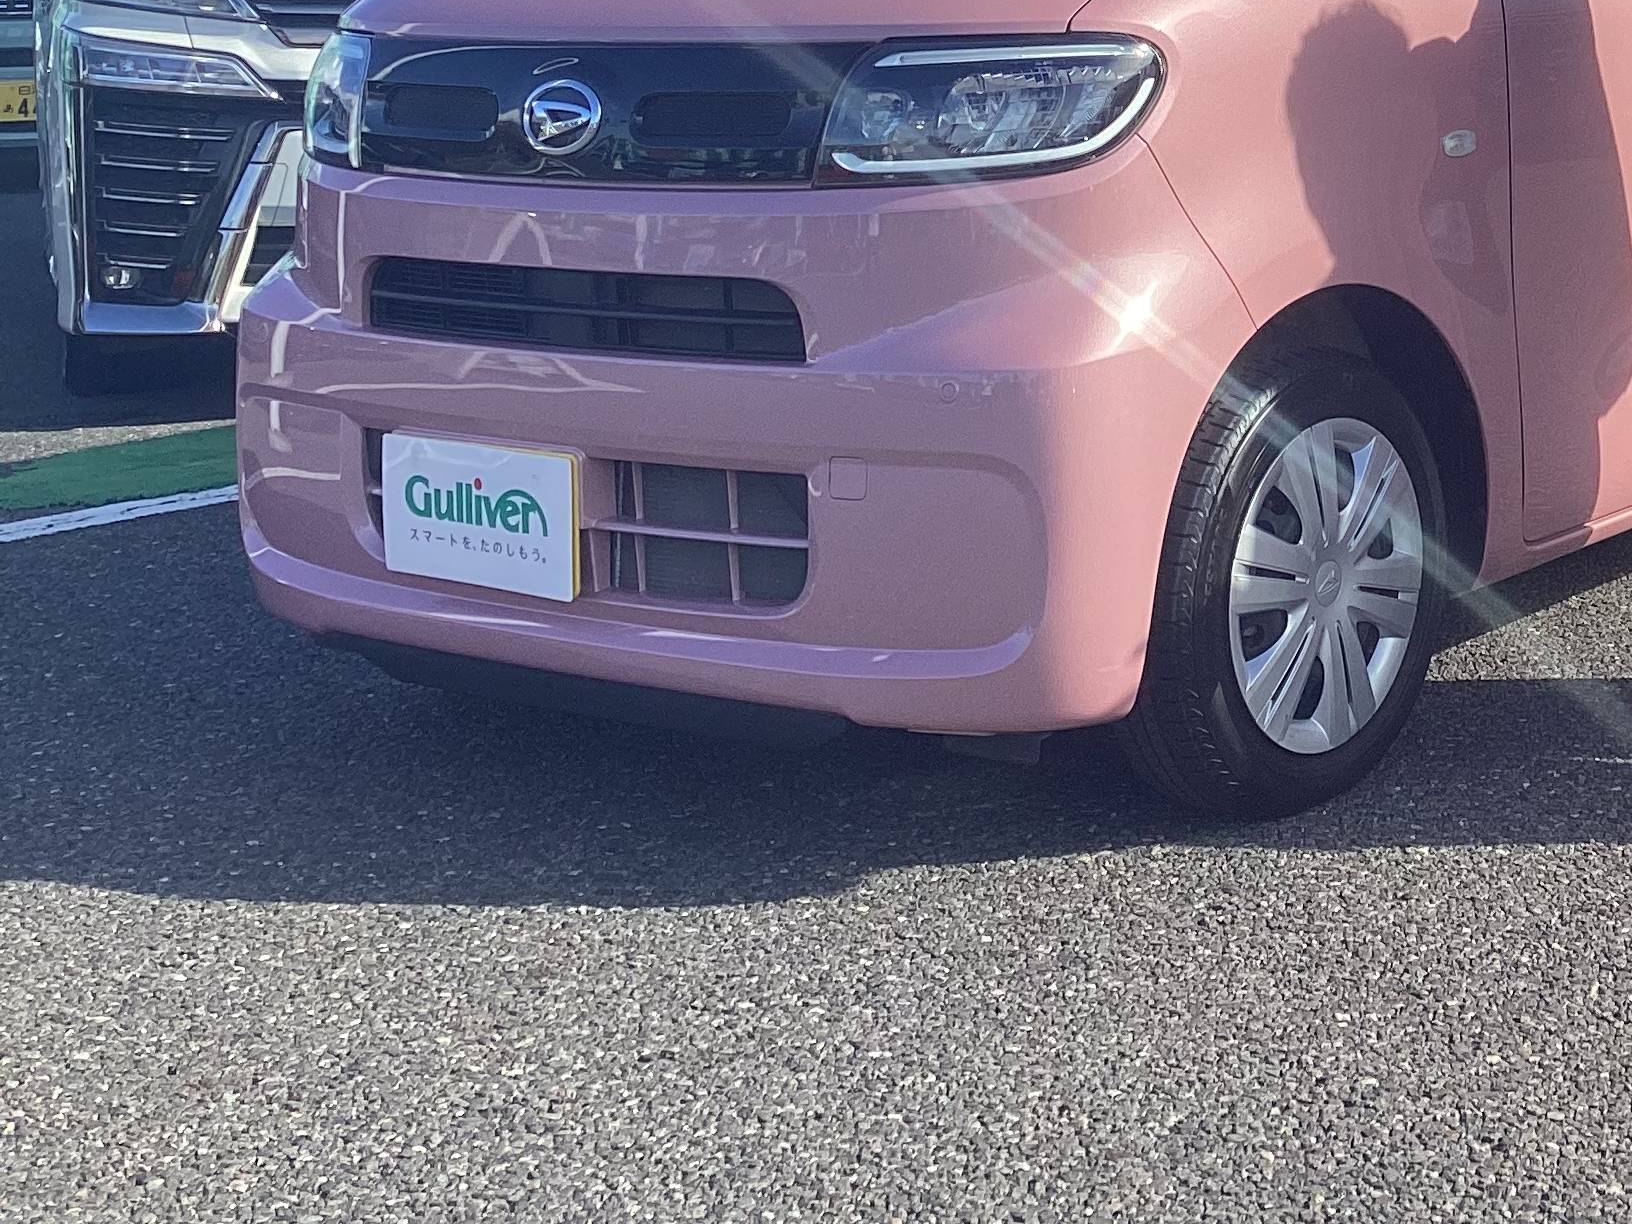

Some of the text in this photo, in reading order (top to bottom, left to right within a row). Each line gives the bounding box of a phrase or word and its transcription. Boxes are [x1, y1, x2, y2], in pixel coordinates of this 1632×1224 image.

[18, 97, 36, 117] 4
[405, 475, 549, 537] Gulliver
[410, 528, 548, 564] スマートを、たのしもう。
